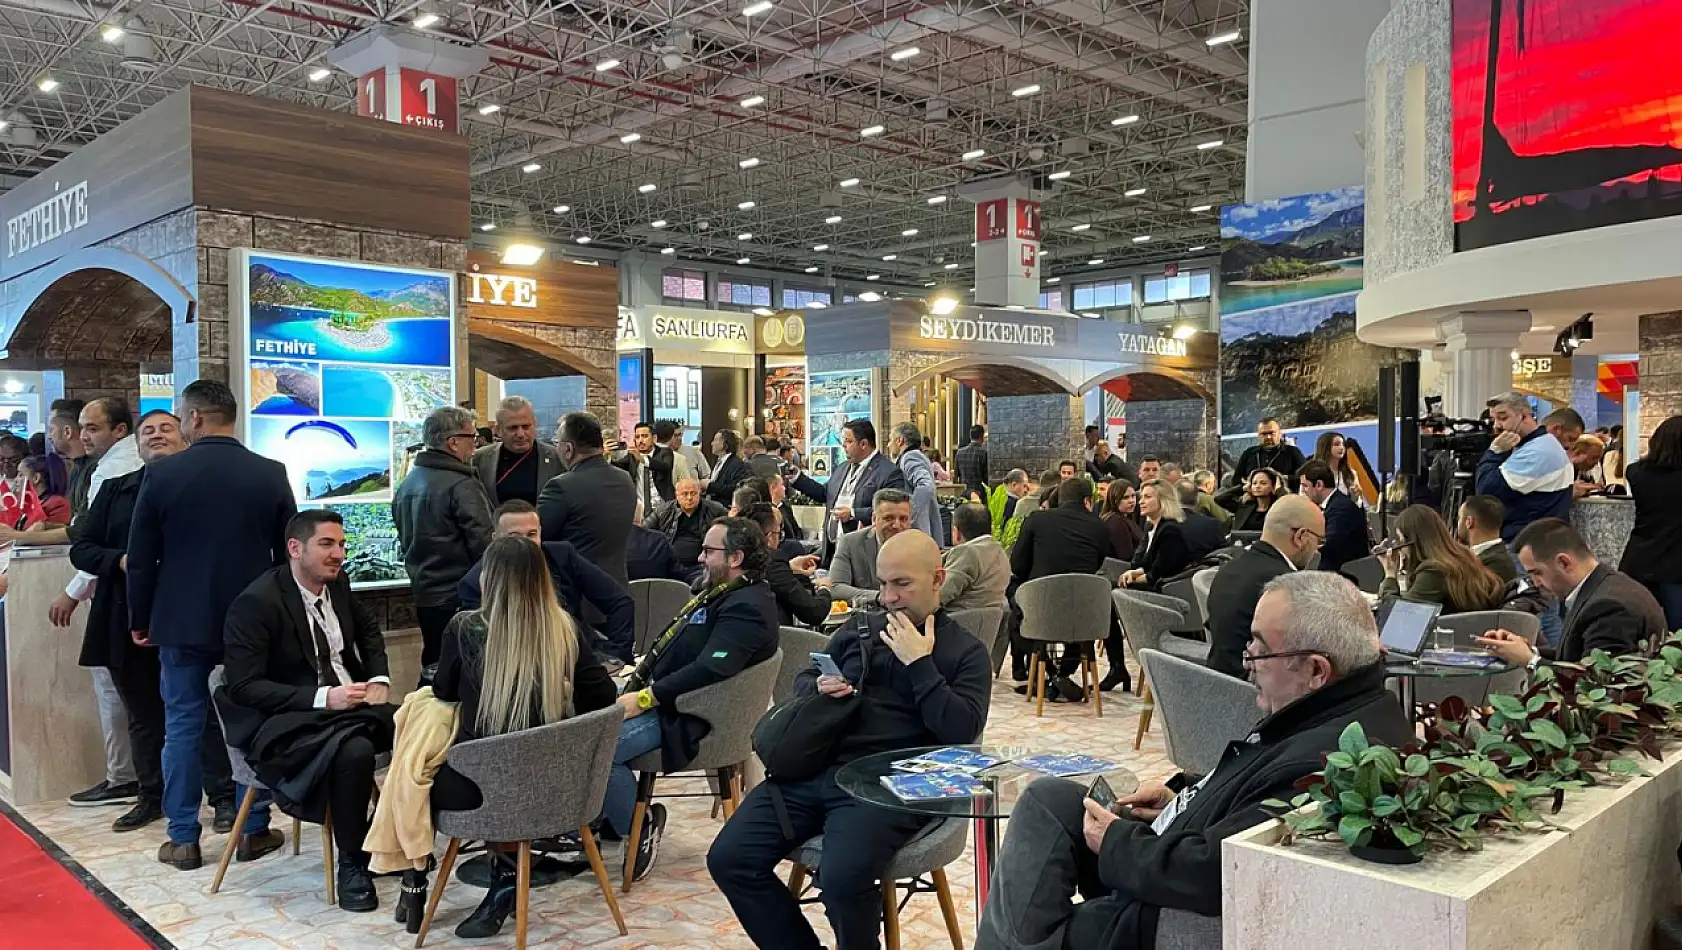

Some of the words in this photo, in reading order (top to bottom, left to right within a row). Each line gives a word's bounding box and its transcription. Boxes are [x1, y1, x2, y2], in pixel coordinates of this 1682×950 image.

[366, 77, 375, 113] 1
[420, 78, 436, 115] 1
[415, 115, 444, 130] ÇIKIŞ
[7, 180, 88, 258] FETHİYE
[986, 204, 996, 227] 1
[1025, 204, 1032, 228] 1
[655, 317, 748, 341] ŞANLIURFA
[920, 313, 1055, 347] SEYDİKEMER
[255, 338, 317, 355] FETHİYE
[1117, 329, 1187, 356] YATAĞAN
